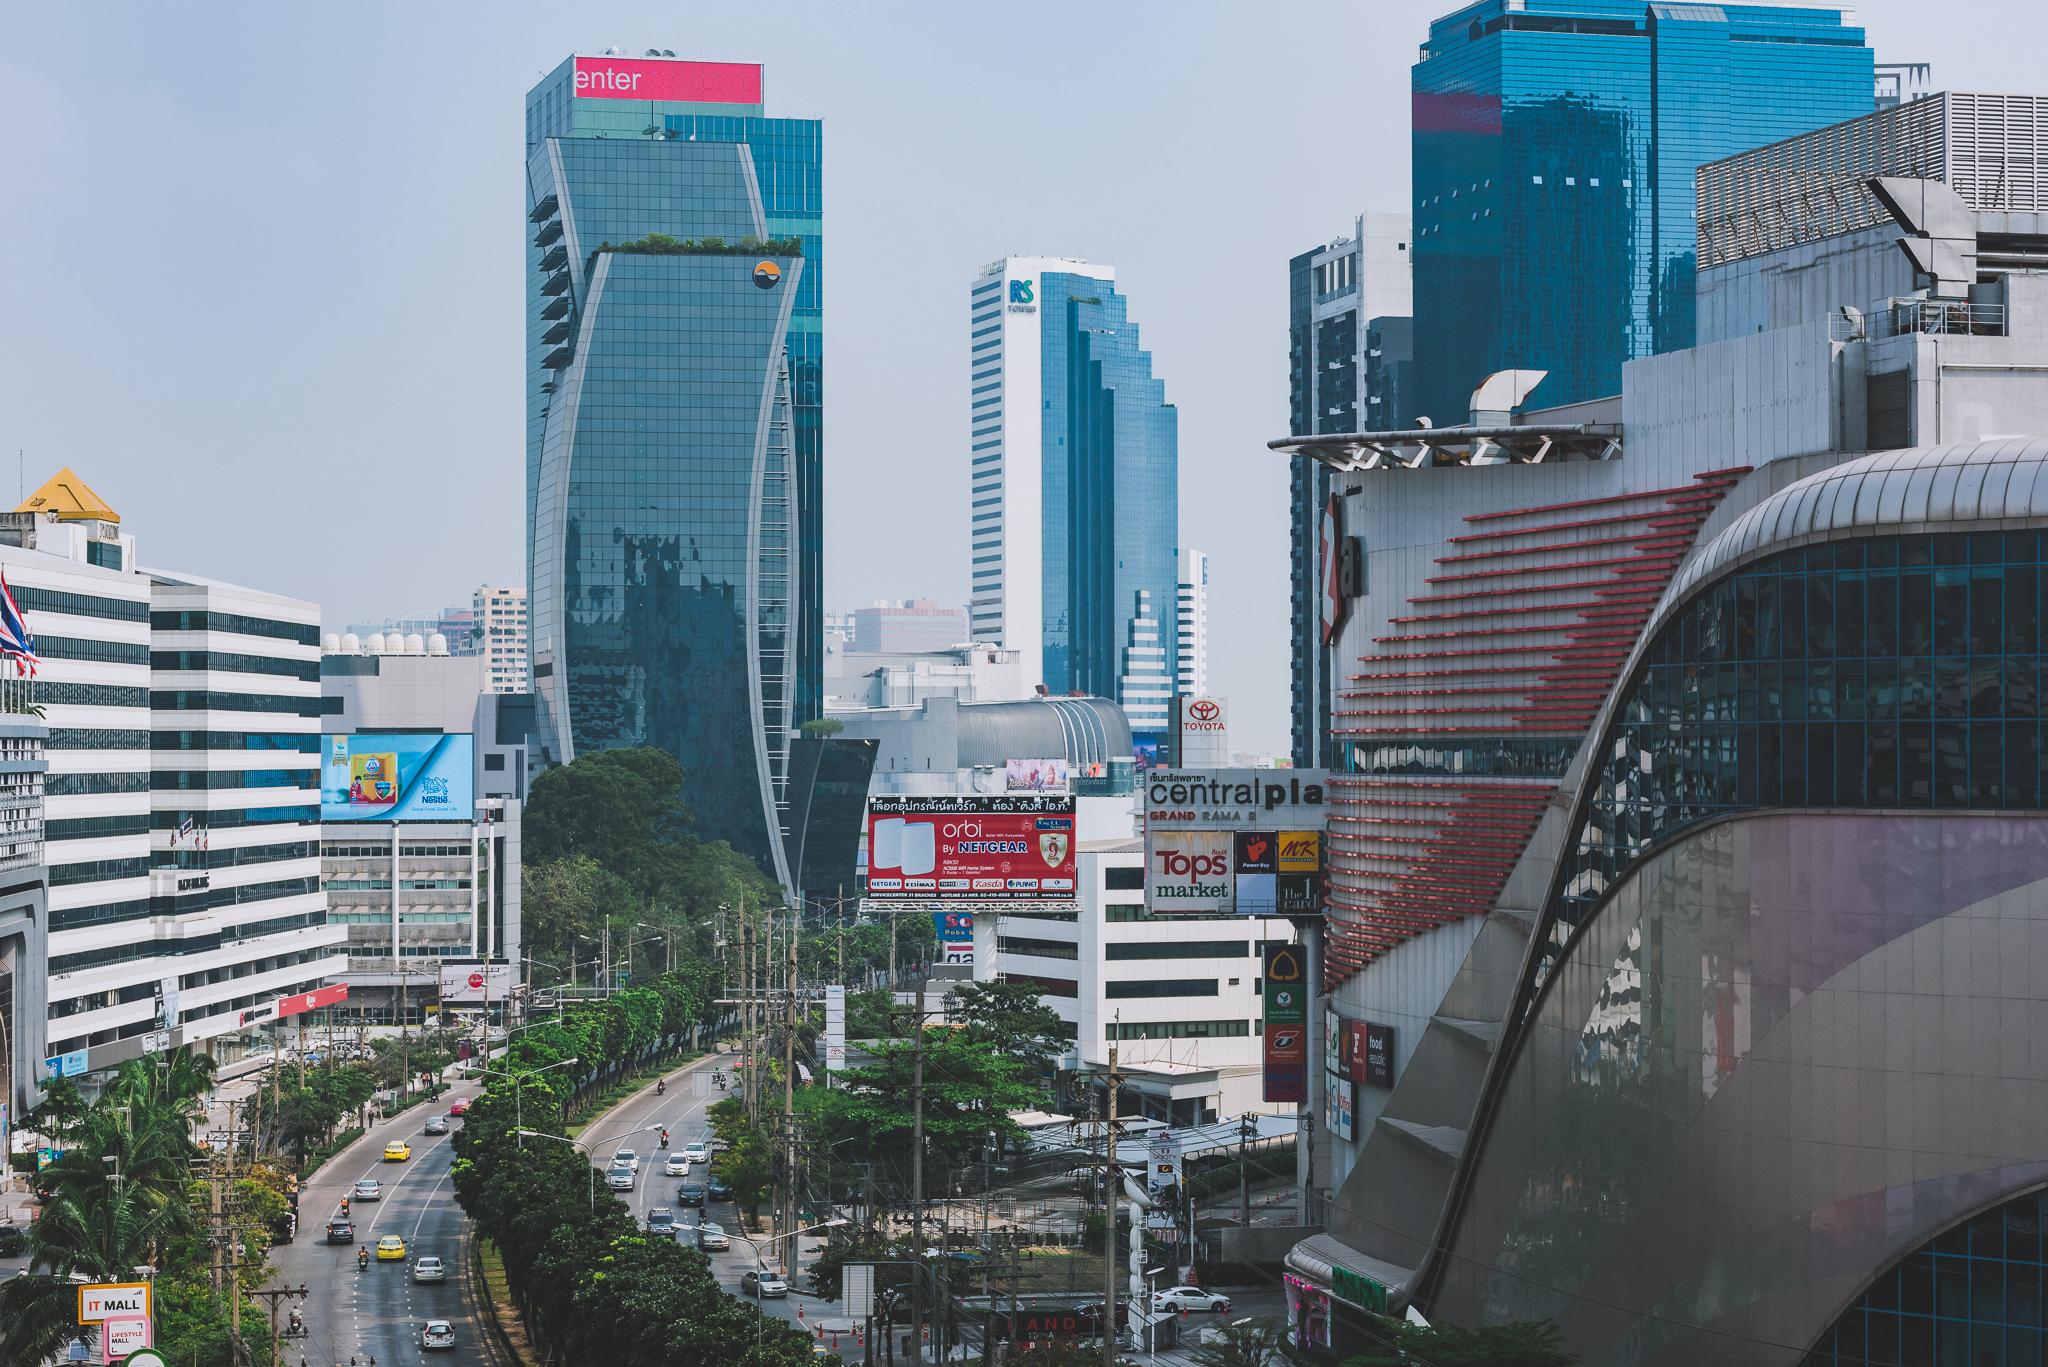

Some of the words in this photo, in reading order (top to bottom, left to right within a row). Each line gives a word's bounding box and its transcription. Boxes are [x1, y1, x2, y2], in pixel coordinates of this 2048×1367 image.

[1010, 279, 1034, 303] RS
[1184, 722, 1225, 731] TOYOTA
[1150, 811, 1196, 821] GRAND
[1202, 811, 1241, 821] RAMA
[943, 819, 982, 838] orbi
[943, 845, 954, 855] By
[958, 841, 1028, 853] NETGEAR
[1281, 840, 1317, 857] MK
[1155, 849, 1228, 884] Tops
[1156, 882, 1229, 898] market
[1283, 888, 1302, 899] The
[1369, 1035, 1383, 1050] food
[88, 1301, 100, 1312] IT
[104, 1300, 140, 1311] MALL
